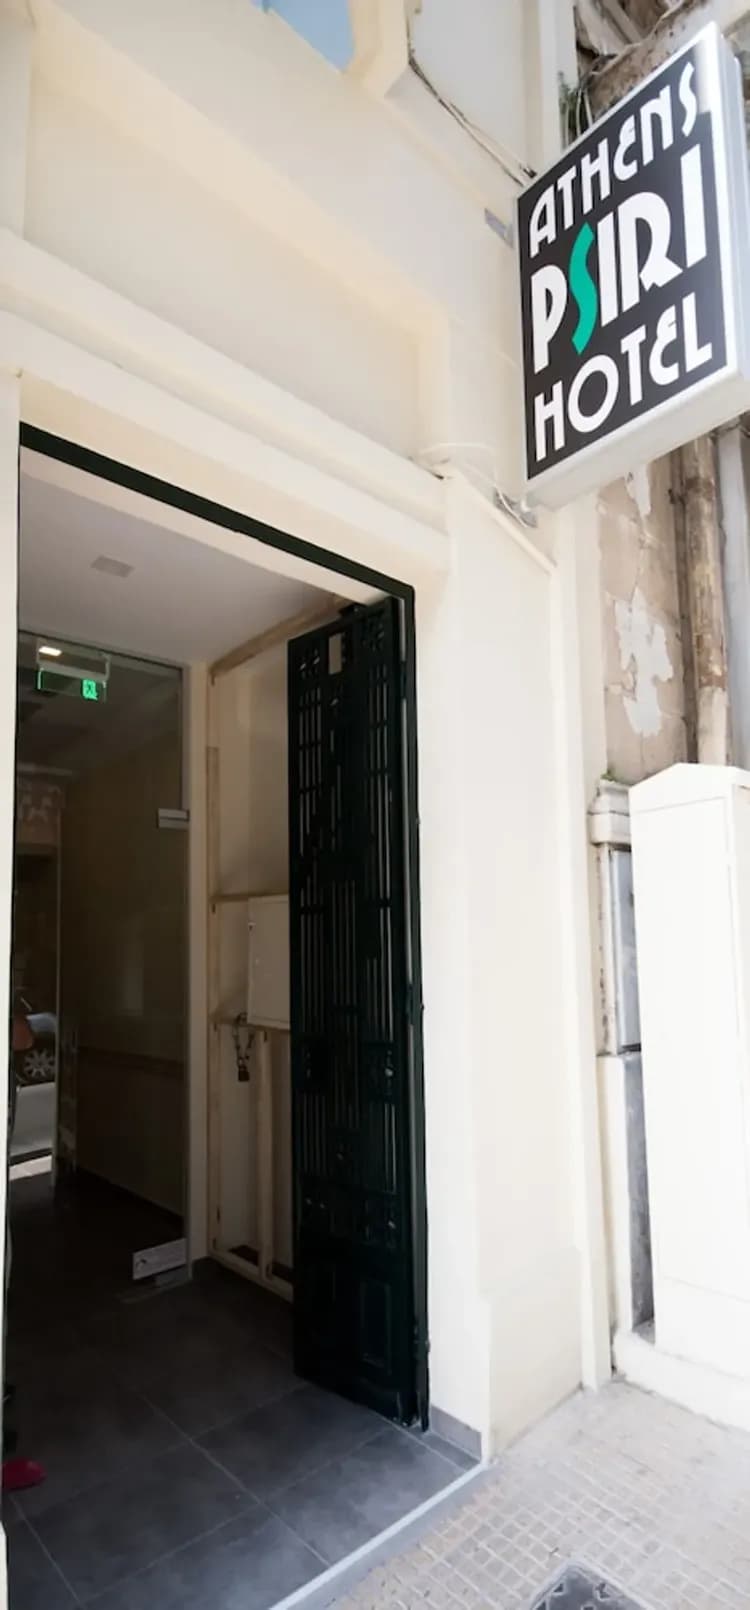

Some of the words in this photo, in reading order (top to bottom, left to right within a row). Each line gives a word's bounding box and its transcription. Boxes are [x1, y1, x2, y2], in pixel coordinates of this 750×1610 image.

[529, 62, 698, 259] ATHENS
[531, 143, 707, 374] PSIRI
[535, 292, 713, 463] HOTEL
